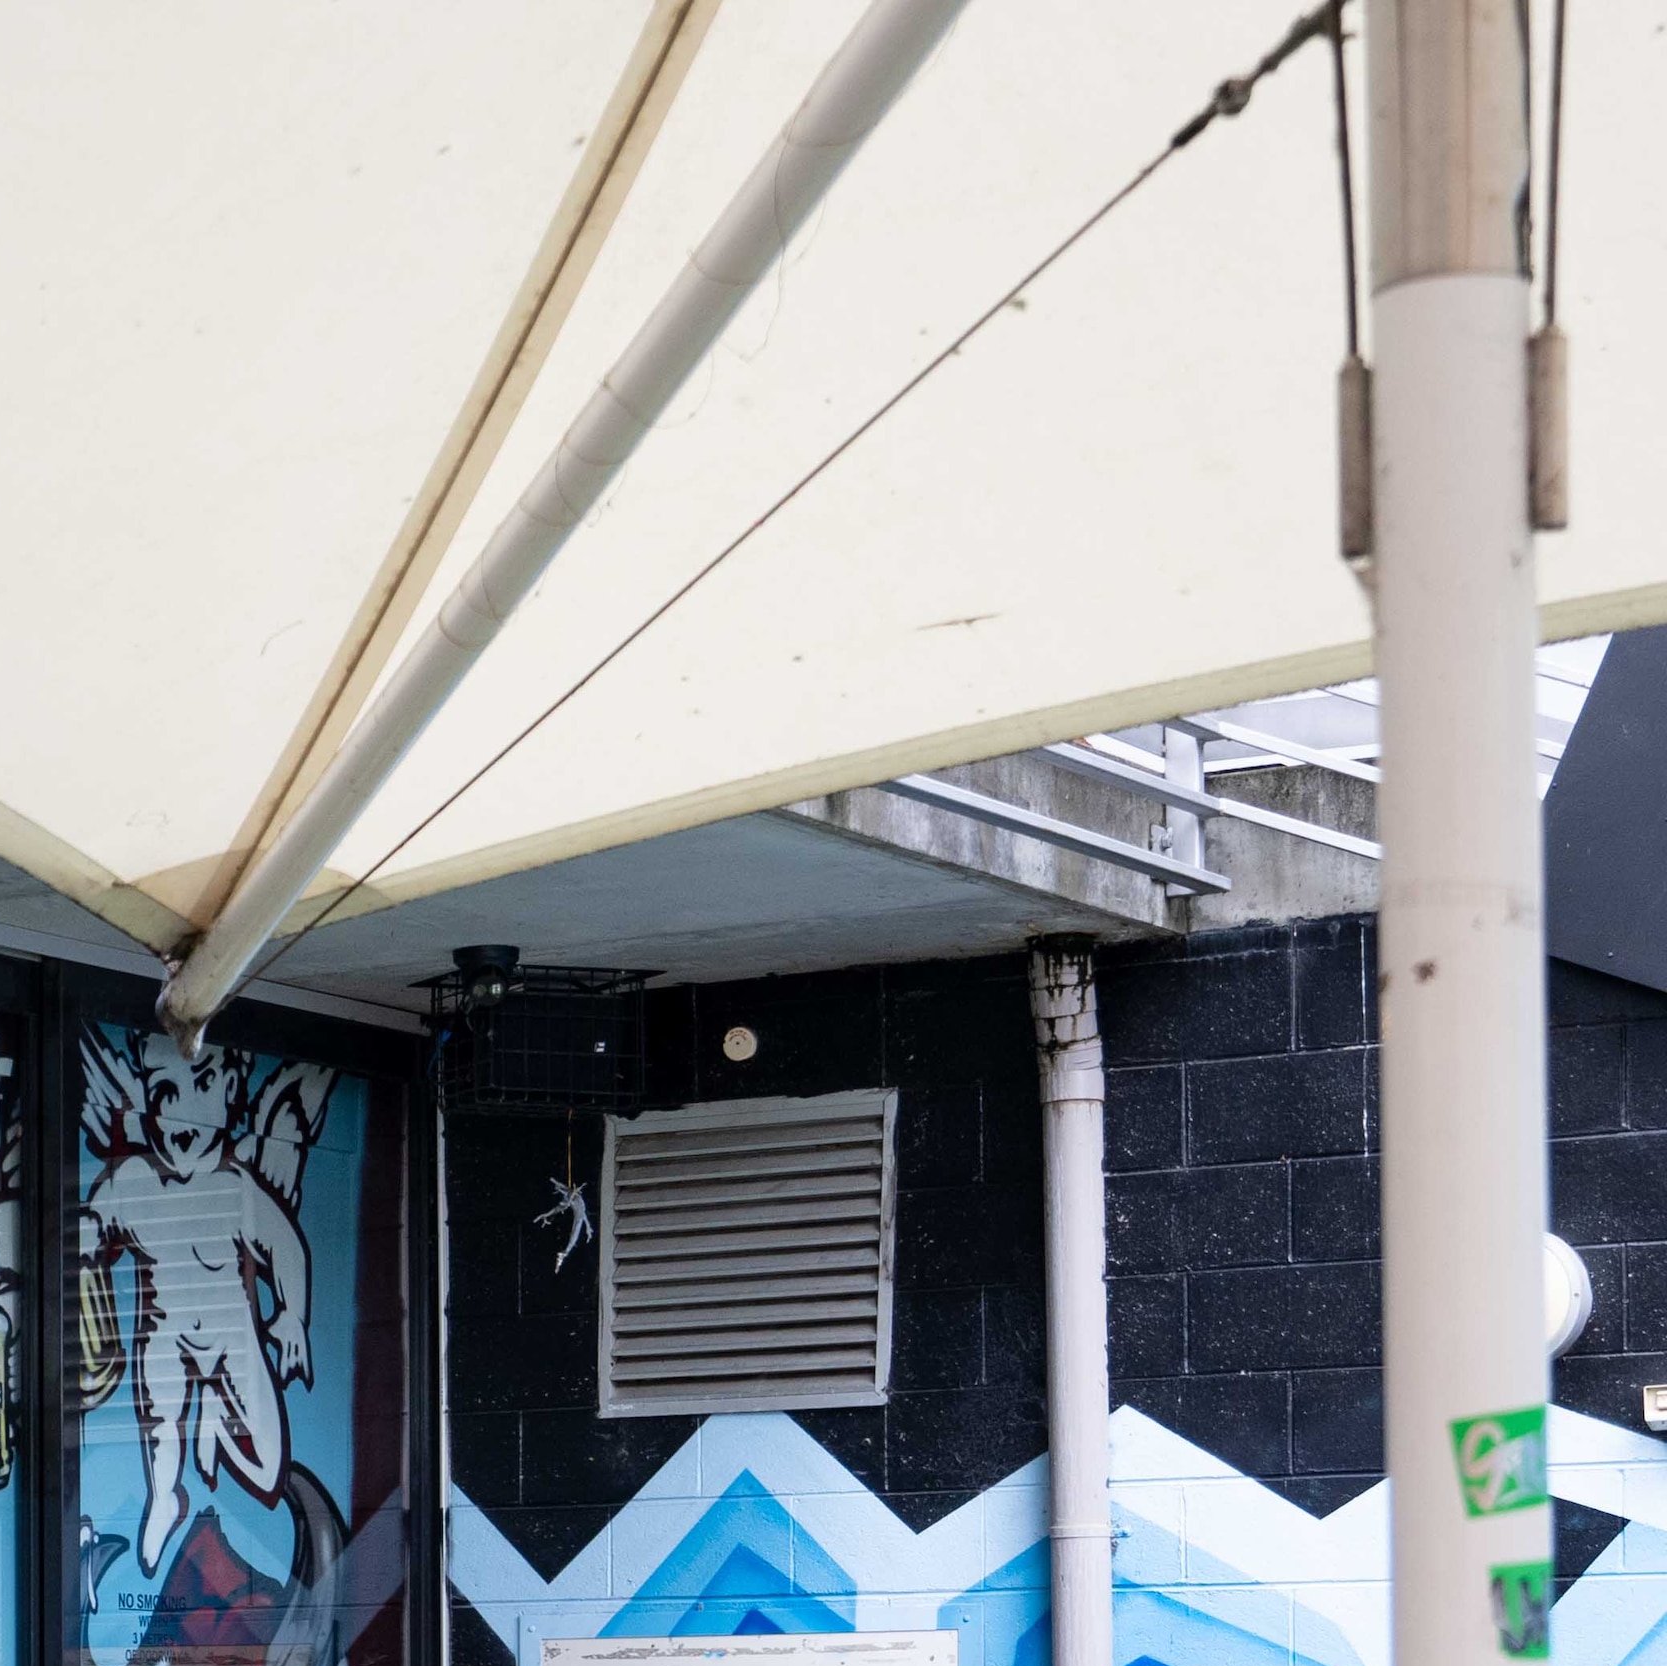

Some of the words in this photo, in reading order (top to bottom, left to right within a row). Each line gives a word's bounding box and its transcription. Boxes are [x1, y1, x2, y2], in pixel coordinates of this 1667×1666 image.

[118, 1593, 134, 1609] NO
[136, 1594, 187, 1610] SMOKING
[132, 1632, 138, 1645] 3
[125, 1648, 137, 1661] OF
